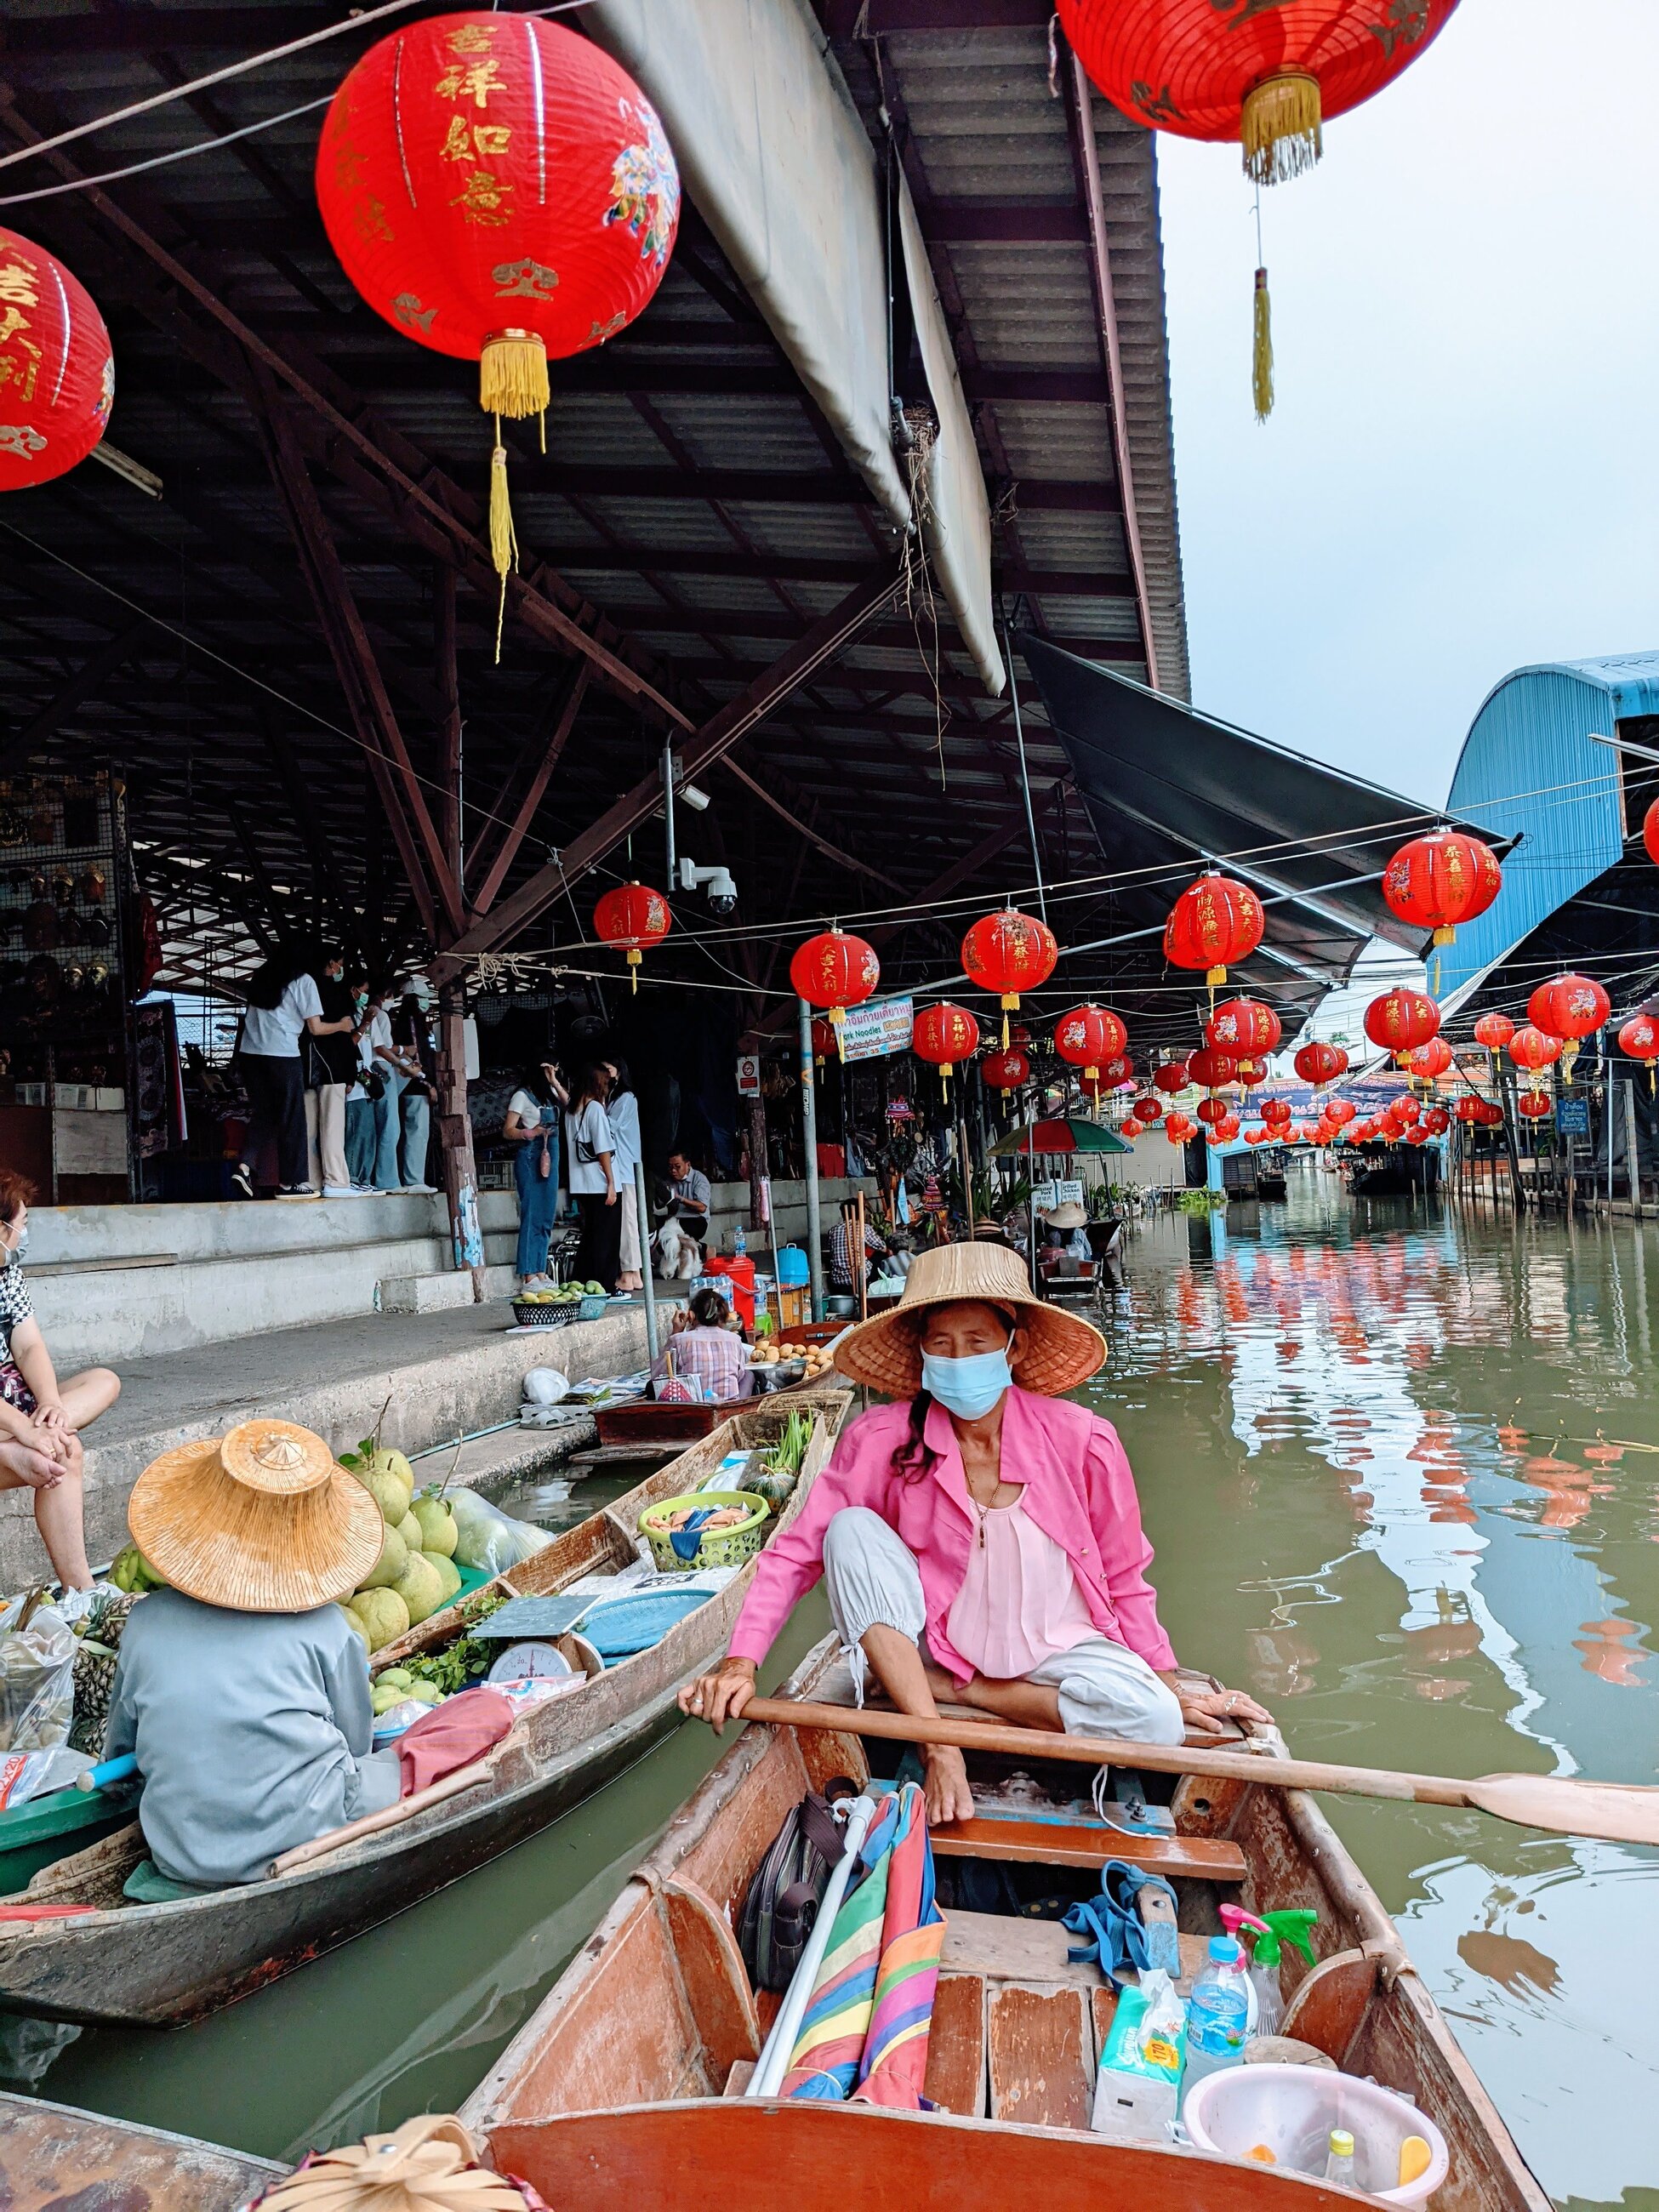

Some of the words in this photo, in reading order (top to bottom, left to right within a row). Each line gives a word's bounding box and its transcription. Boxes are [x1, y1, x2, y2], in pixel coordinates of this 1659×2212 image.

[436, 25, 514, 226] 吉祥如意
[855, 1026, 881, 1038] Noodles
[1151, 2043, 1167, 2061] 170
